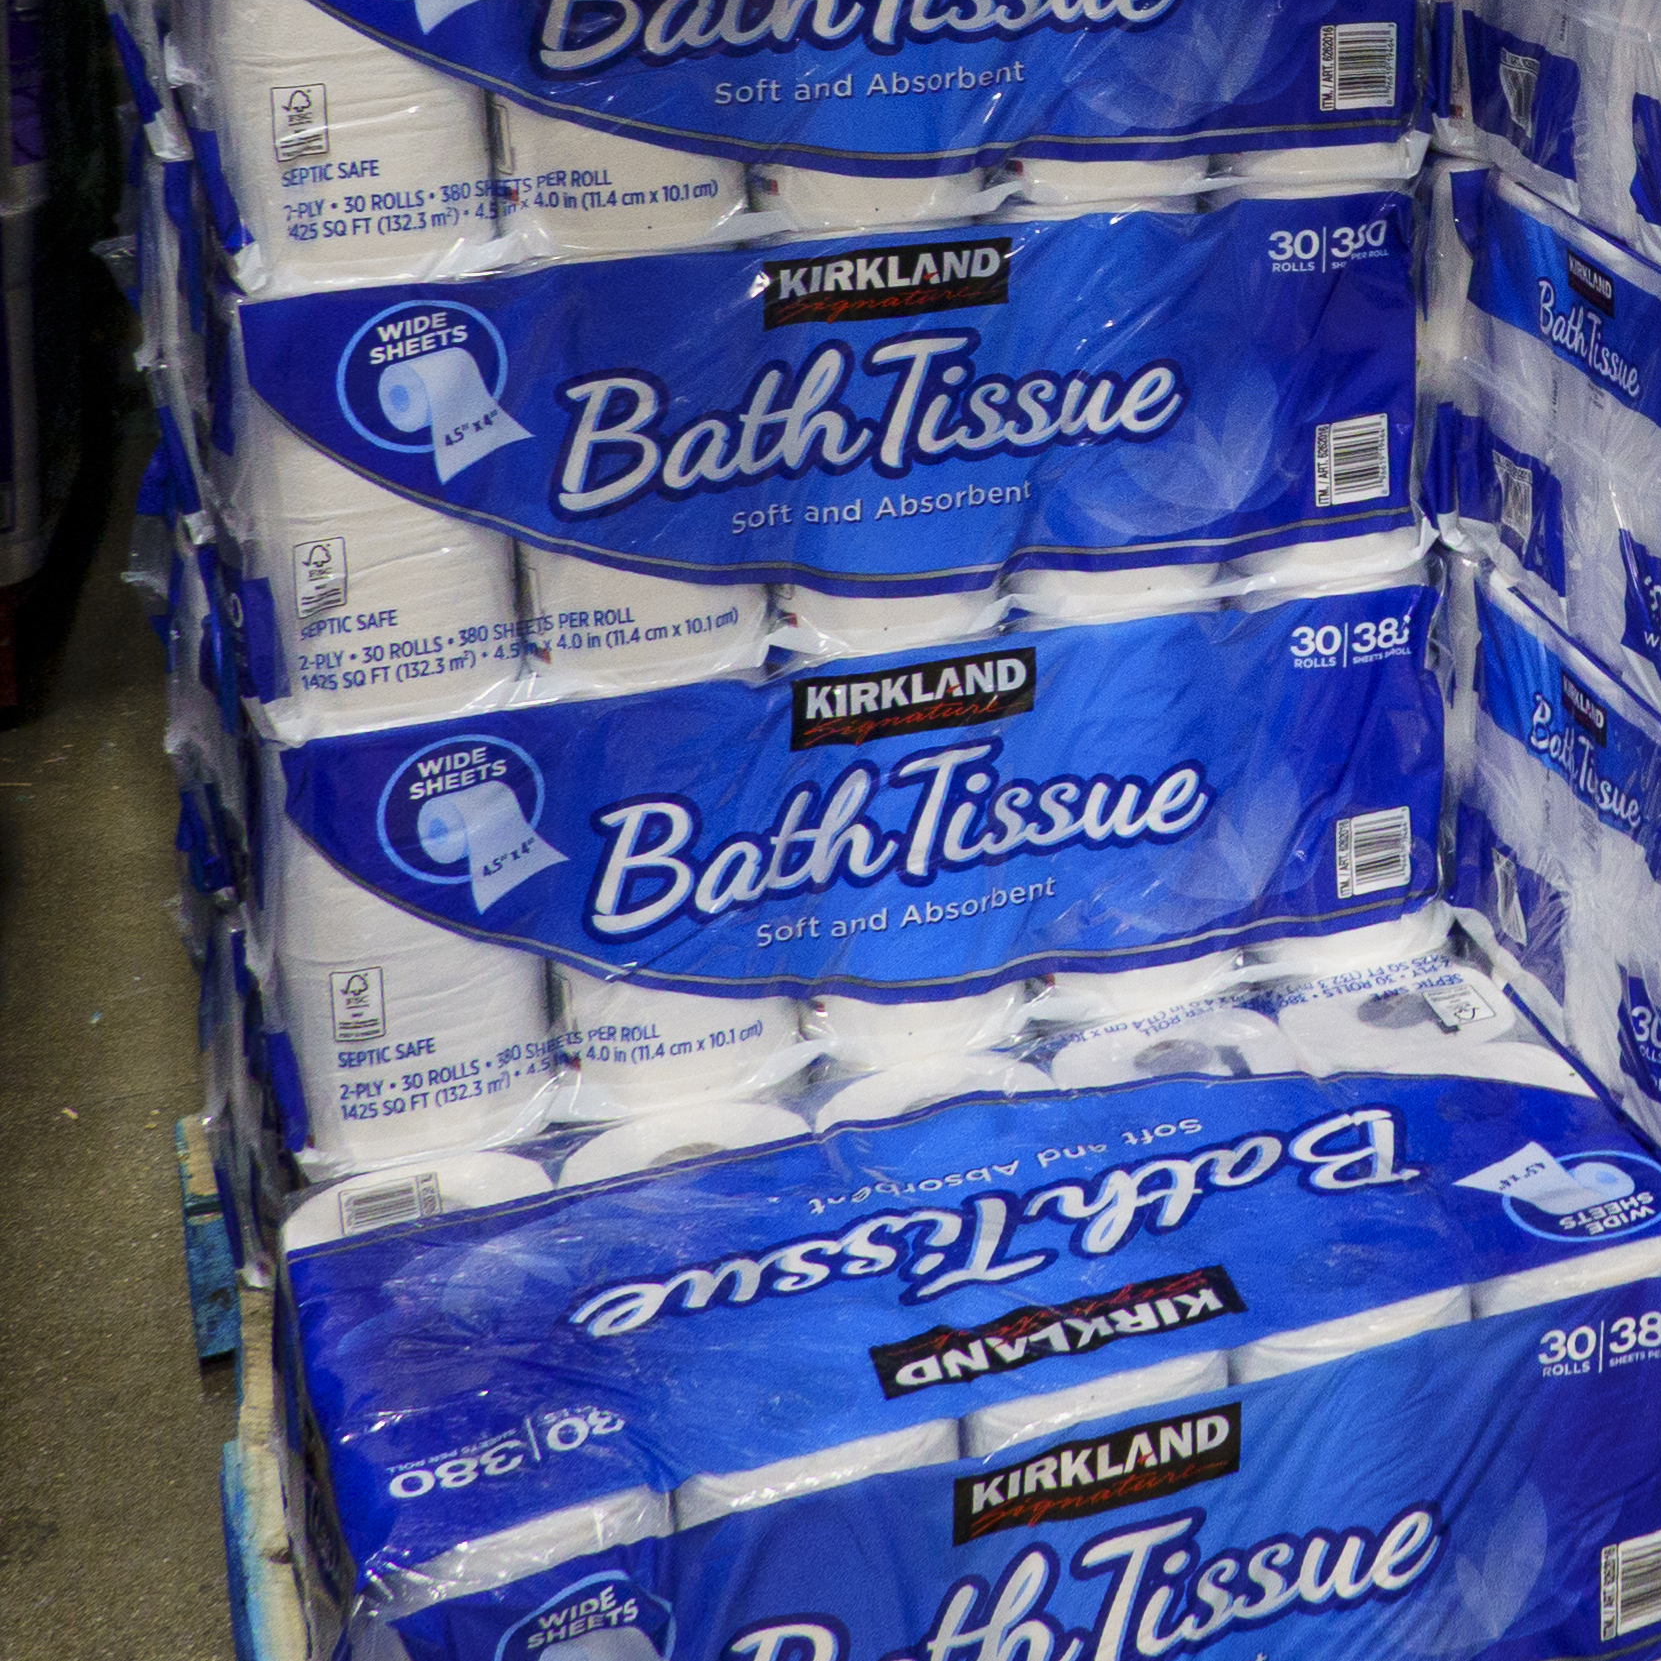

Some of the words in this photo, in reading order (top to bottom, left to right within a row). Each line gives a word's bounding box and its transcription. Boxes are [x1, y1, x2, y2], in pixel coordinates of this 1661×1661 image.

[714, 82, 781, 106] Soft
[795, 76, 853, 100] and
[866, 61, 1026, 97] Absorbent
[778, 243, 1000, 300] KIRKLAND
[558, 350, 868, 512] Bath
[868, 335, 1180, 472] Tissue
[804, 659, 1027, 725] KIRKLAND
[591, 772, 892, 936] Bath
[894, 747, 1205, 875] Tissue
[338, 1044, 392, 1069] SEPTIC
[395, 1037, 436, 1058] SAFE
[1039, 1142, 1107, 1164] and
[1123, 1119, 1202, 1145] Soft
[808, 1155, 1018, 1215] Absorbent
[1028, 1110, 1420, 1253] Bath
[571, 1197, 1047, 1339] Tissue
[895, 1288, 1224, 1386] KIRKLAND
[1537, 1326, 1595, 1365] 30
[1542, 1360, 1591, 1378] ROLLS
[972, 1414, 1230, 1512] KIRKLAND
